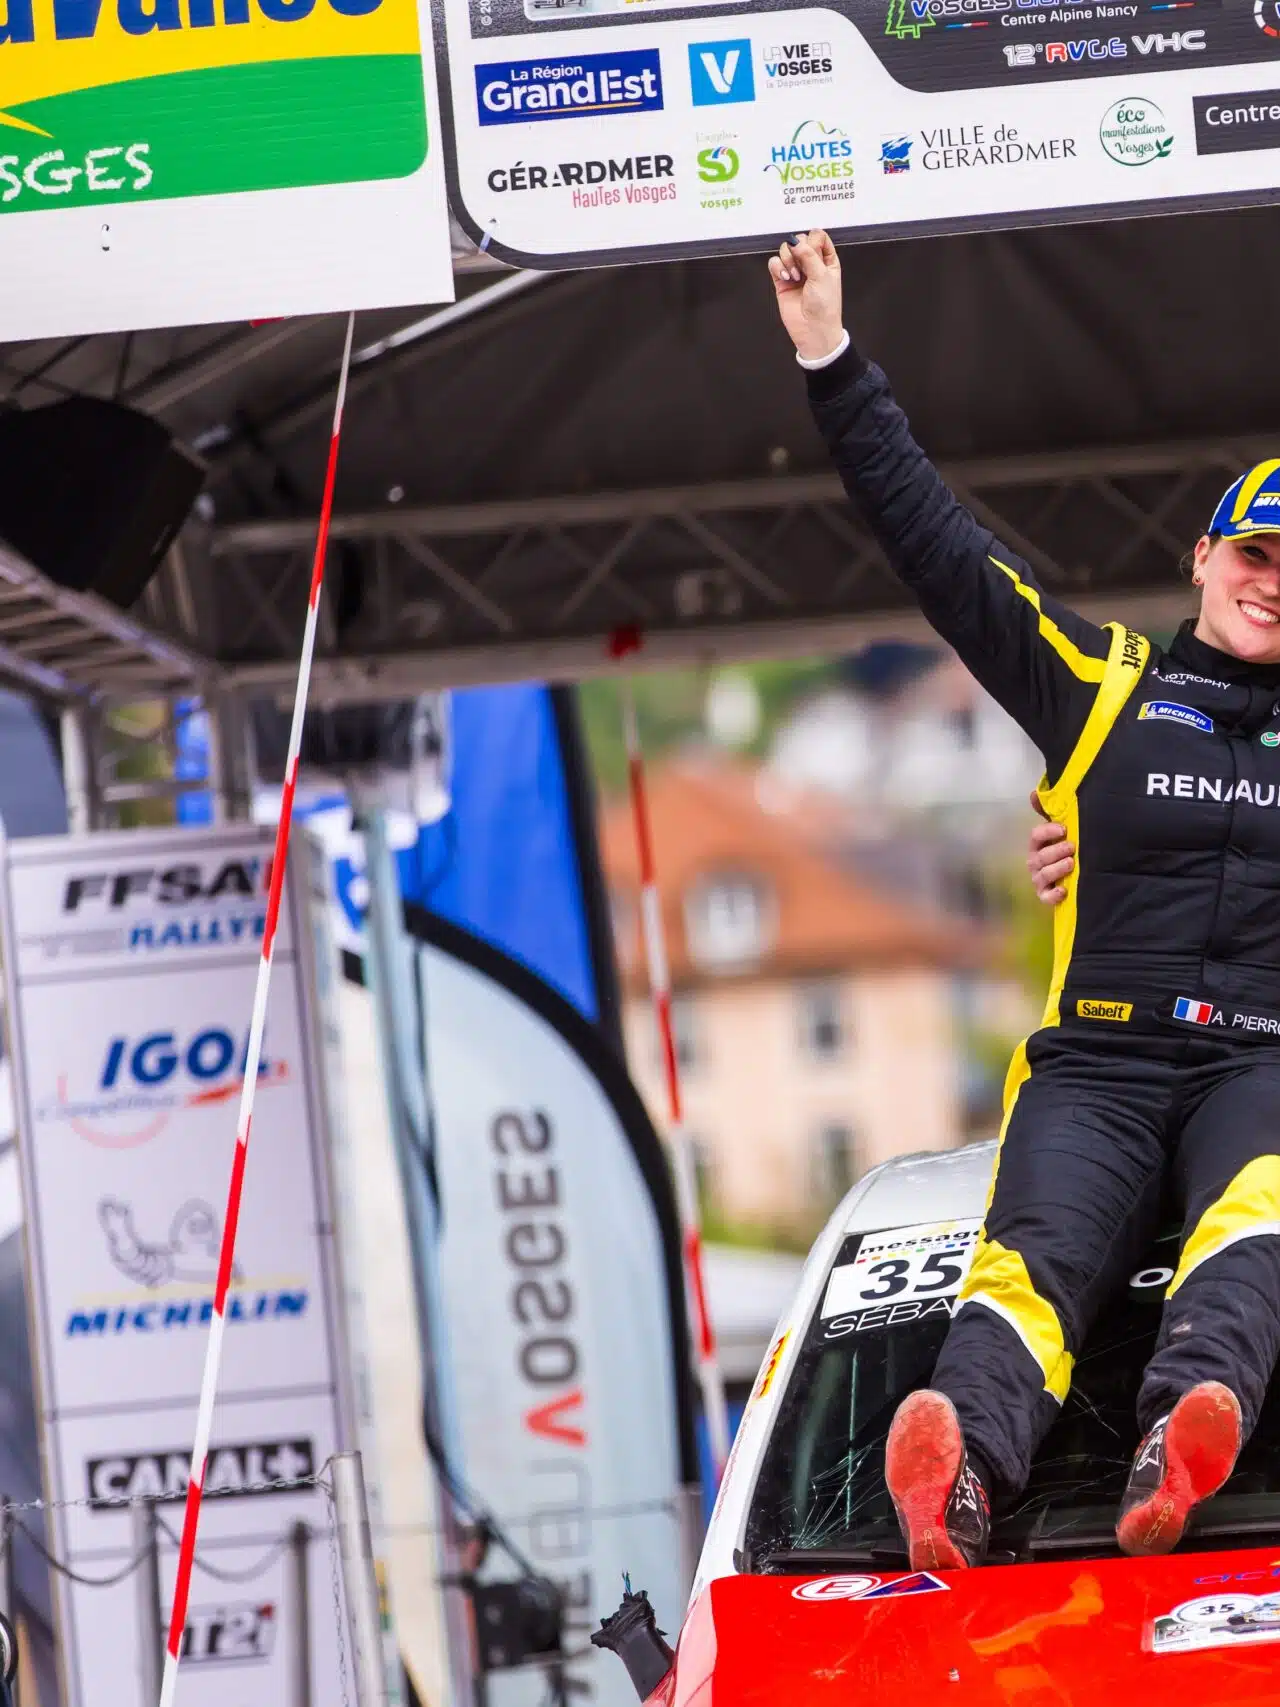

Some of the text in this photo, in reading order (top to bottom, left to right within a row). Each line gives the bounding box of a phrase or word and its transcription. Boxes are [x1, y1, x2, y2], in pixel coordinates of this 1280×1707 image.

[1001, 5, 1138, 27] Centre Alpine Nancy
[783, 44, 810, 59] VIE
[1045, 36, 1127, 63] RVGE
[1131, 29, 1207, 56] VHC
[511, 64, 583, 82] La Région
[765, 58, 833, 78] VOSGES
[1116, 104, 1145, 124] éco
[921, 123, 1018, 148] VILLE de
[1102, 124, 1166, 141] manifestations
[771, 140, 853, 162] HAUTES
[923, 138, 1077, 171] GERARDMER
[1115, 141, 1155, 158] Vosges
[487, 154, 675, 193] GÉRARDMER
[779, 160, 854, 185] VOSGES
[783, 181, 855, 196] communauté
[784, 191, 855, 205] de communes
[700, 197, 742, 210] vosges
[1121, 631, 1143, 670] abelt
[1162, 673, 1231, 690] IOTROPHY
[1158, 707, 1207, 726] MICHELIN
[64, 858, 255, 911] FFSA
[1082, 1001, 1124, 1019] Sabelt
[1212, 1011, 1227, 1026] A.
[859, 1250, 966, 1301] 35
[1199, 1603, 1236, 1617] 35
